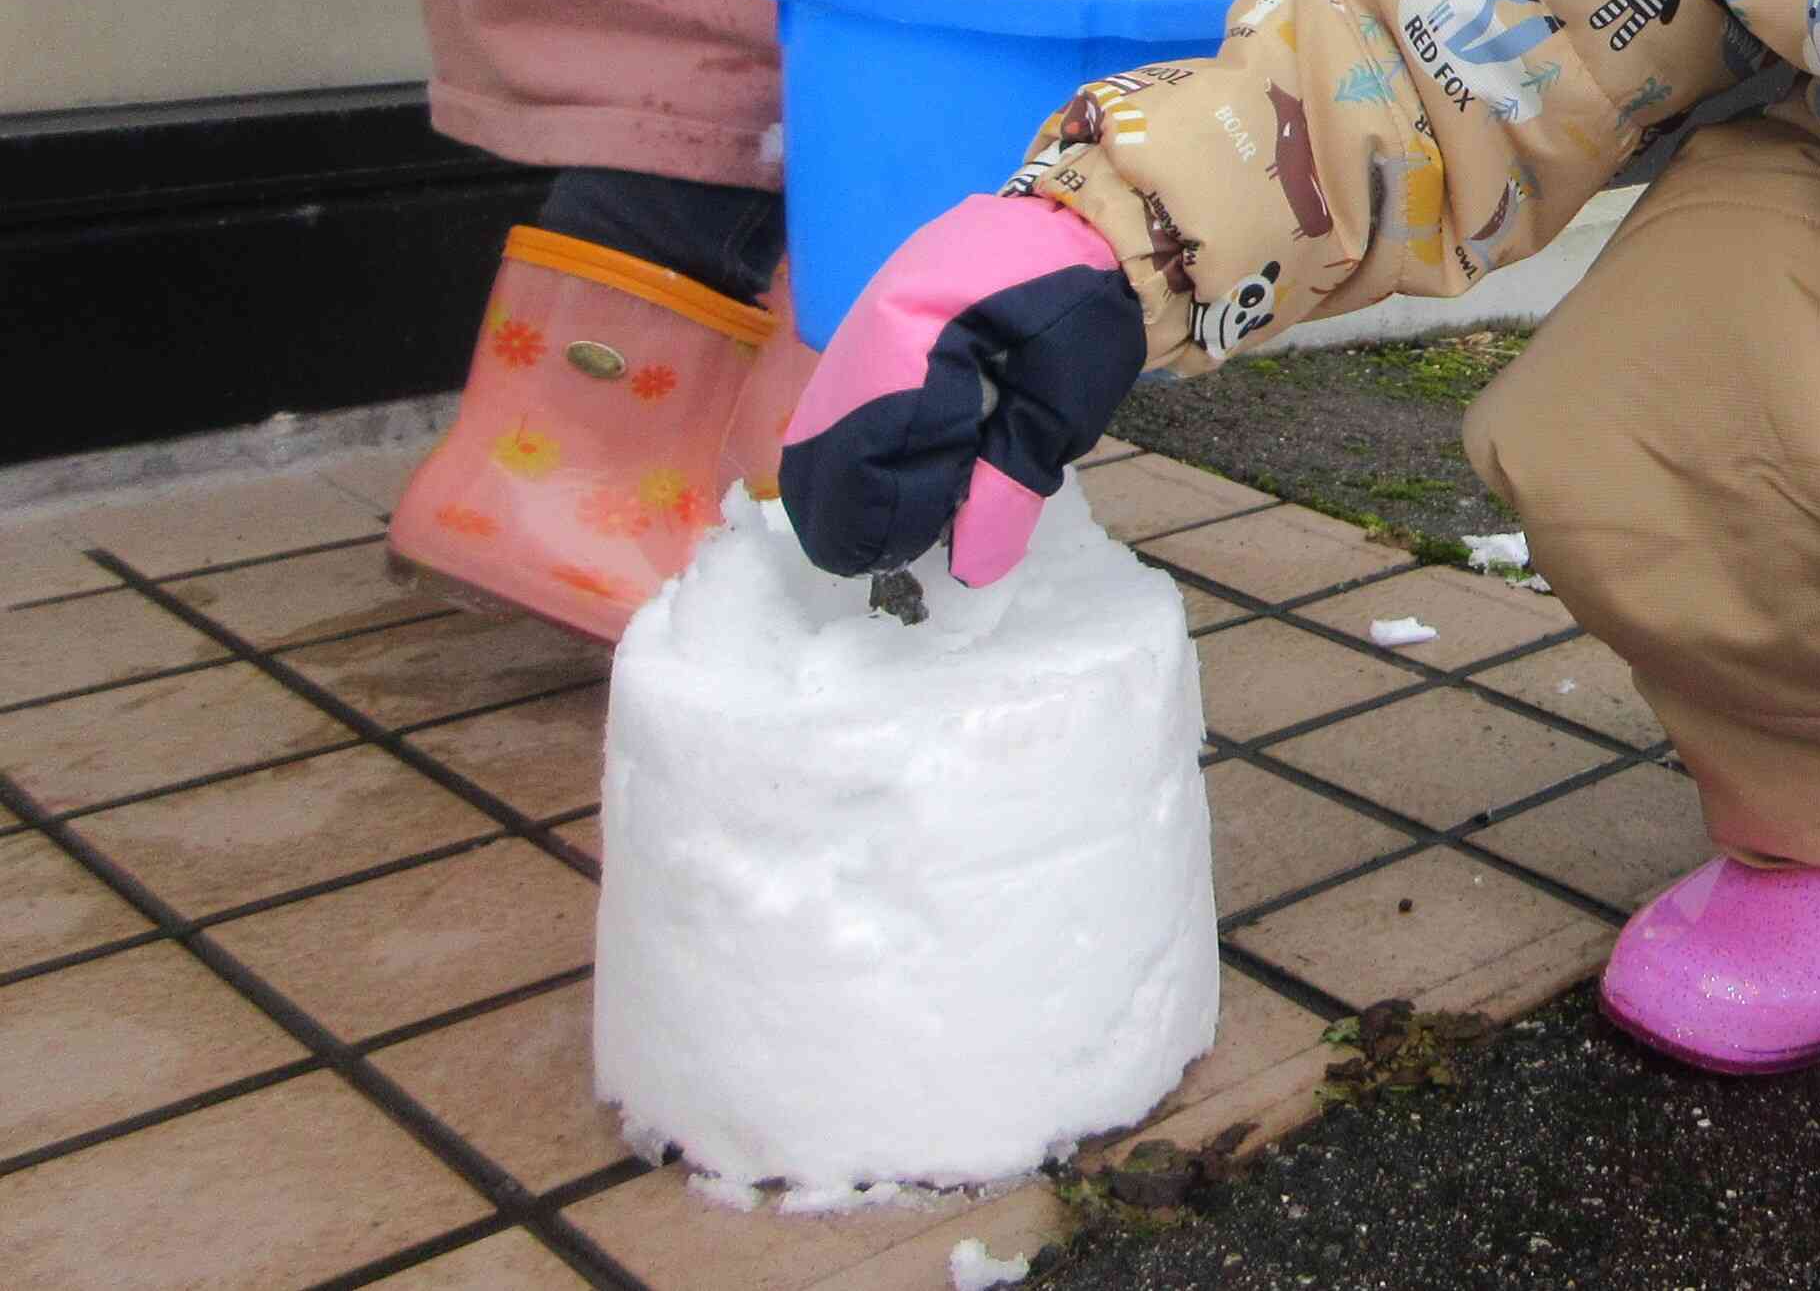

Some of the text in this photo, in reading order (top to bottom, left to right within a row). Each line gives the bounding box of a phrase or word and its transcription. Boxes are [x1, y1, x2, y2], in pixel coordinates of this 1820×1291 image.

[1404, 14, 1477, 113] RED FOX
[1214, 104, 1258, 165] BOAR
[1455, 244, 1479, 280] OWL
